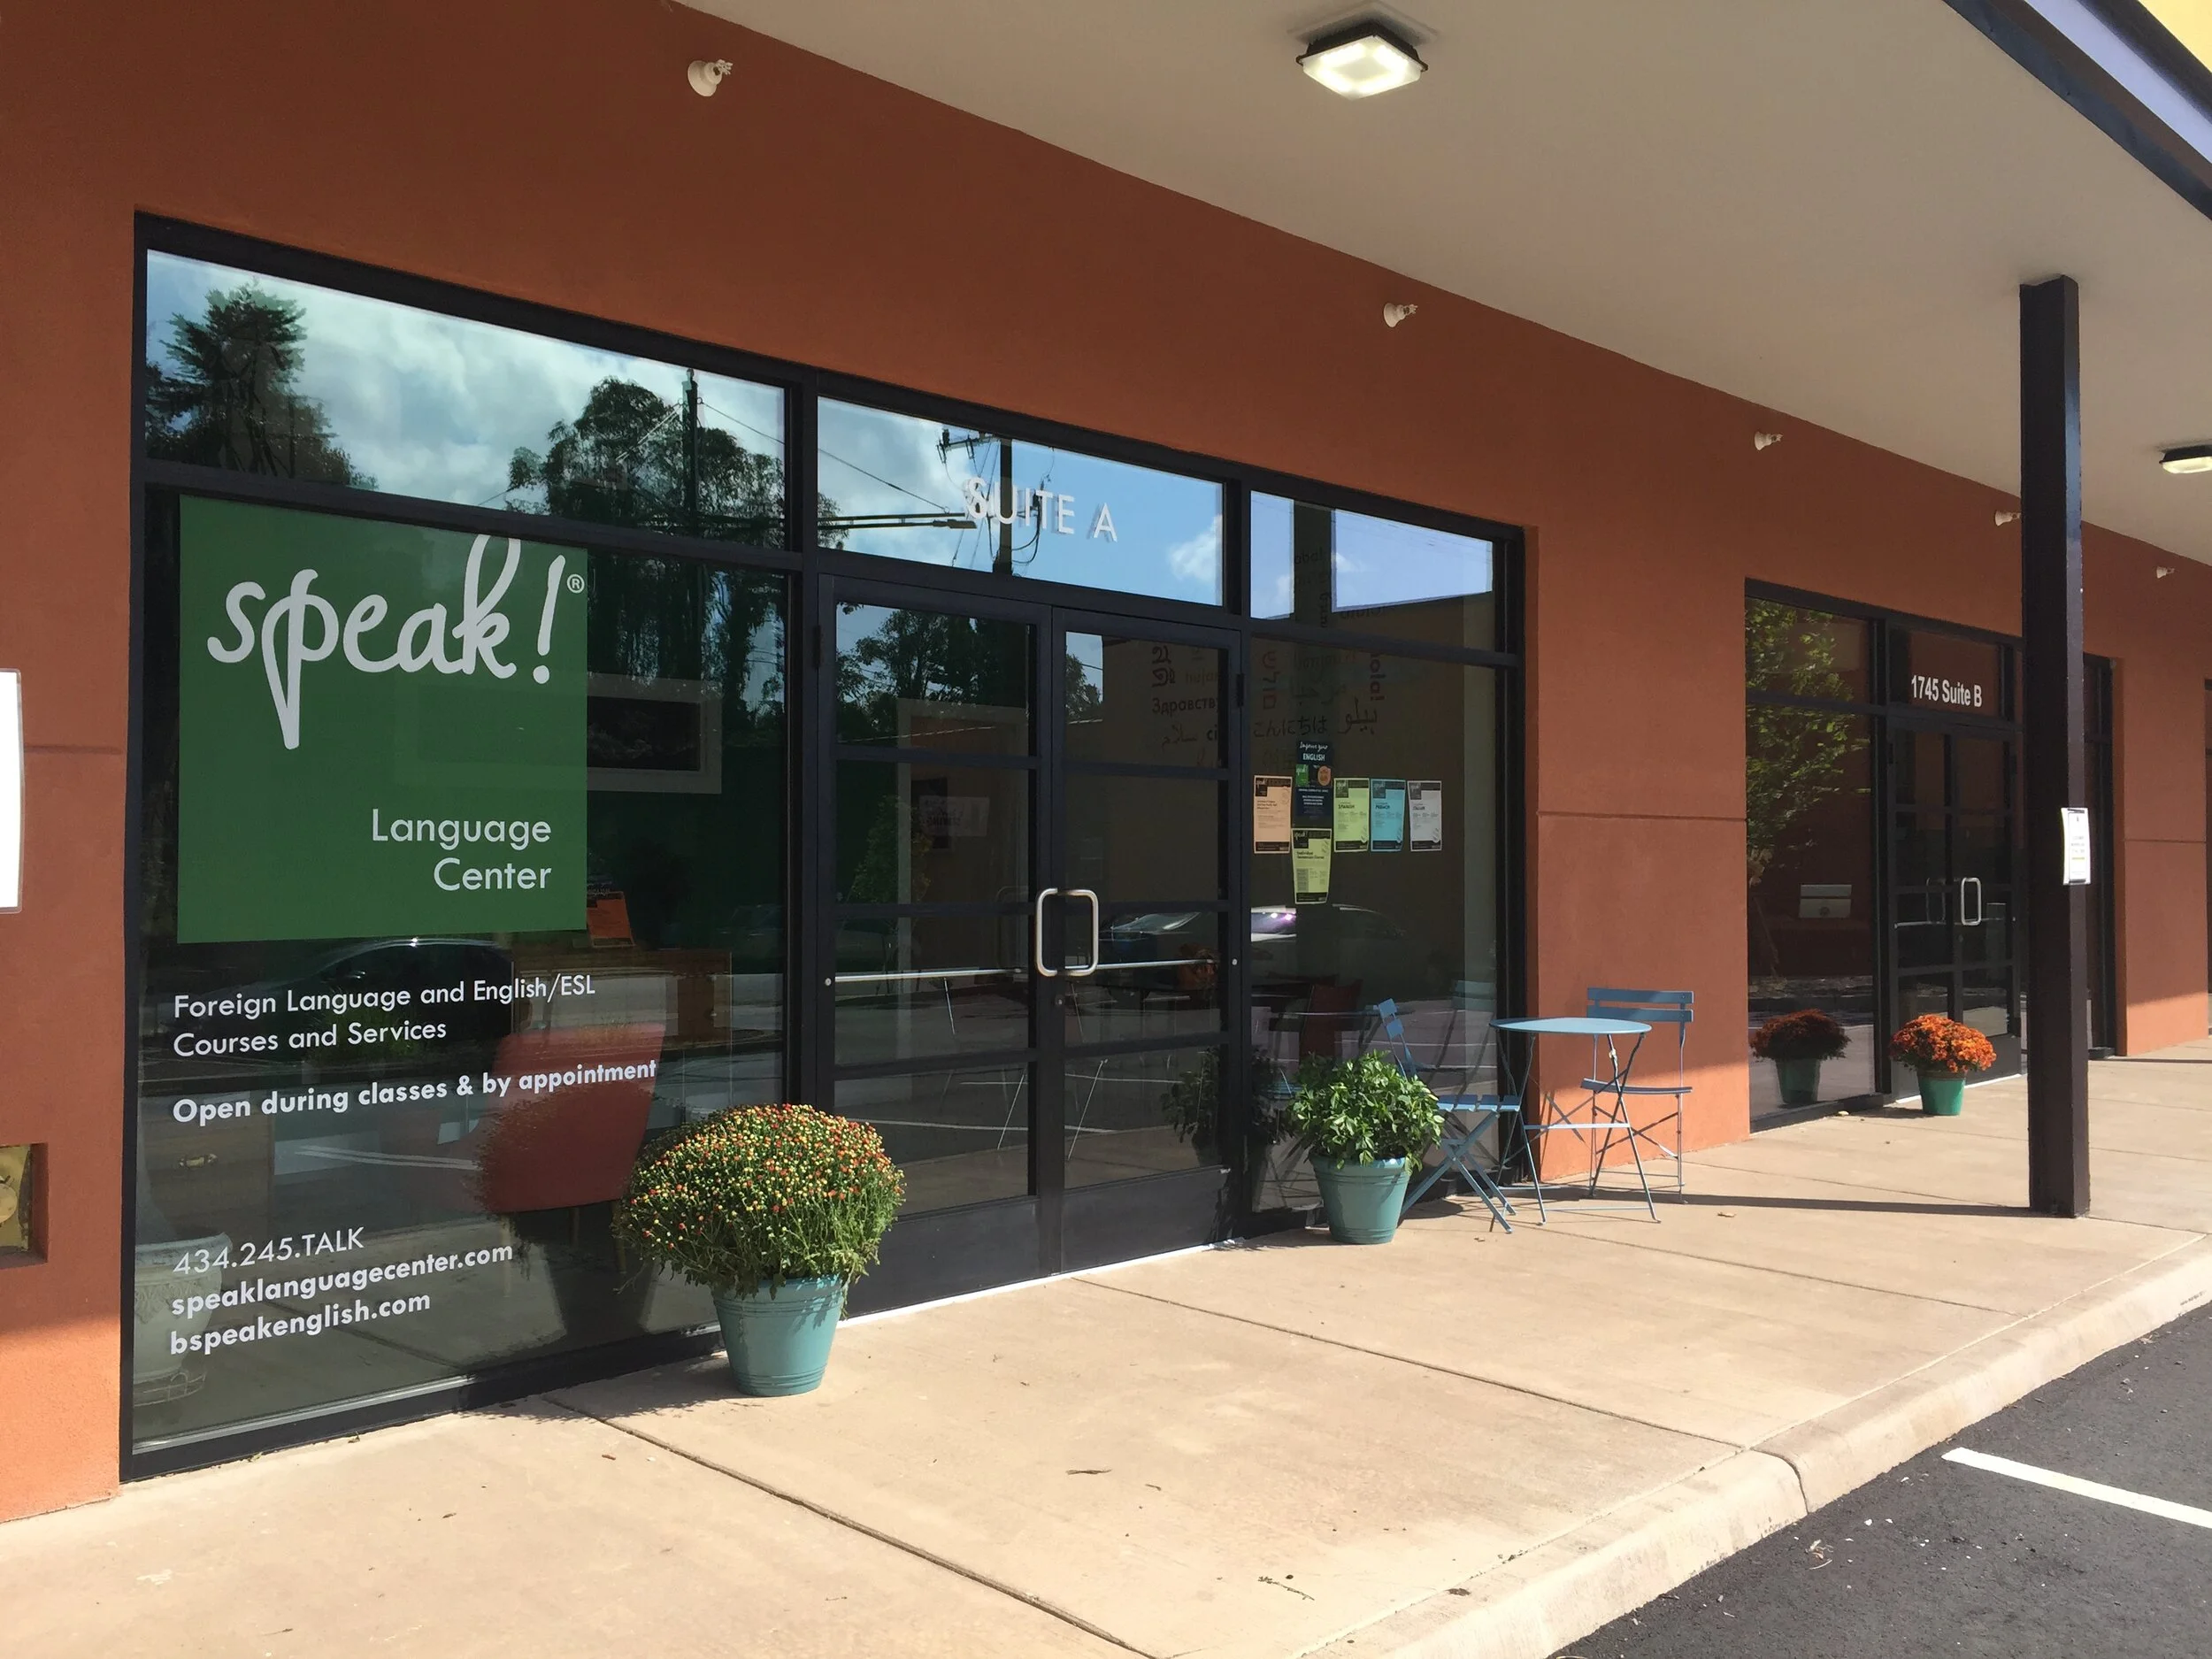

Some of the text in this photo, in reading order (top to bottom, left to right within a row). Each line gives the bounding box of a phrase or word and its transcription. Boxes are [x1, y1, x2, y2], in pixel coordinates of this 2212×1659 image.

[966, 476, 1118, 542] SUITE A
[206, 534, 566, 750] speak!
[1911, 674, 1982, 708] 1745 Suite B
[1302, 753, 1325, 762] ENGLISH
[372, 808, 552, 850] Language
[433, 856, 552, 892] Center
[173, 973, 596, 1021] Foreign Language and English/ESL
[173, 1019, 448, 1058] Courses and Services
[173, 1060, 658, 1127] Open during classes & by appointment
[173, 1226, 365, 1275] 434.245.TALK
[172, 1244, 513, 1319] speaklanguagecenter.com
[170, 1293, 431, 1355] bspeakenglish.com
